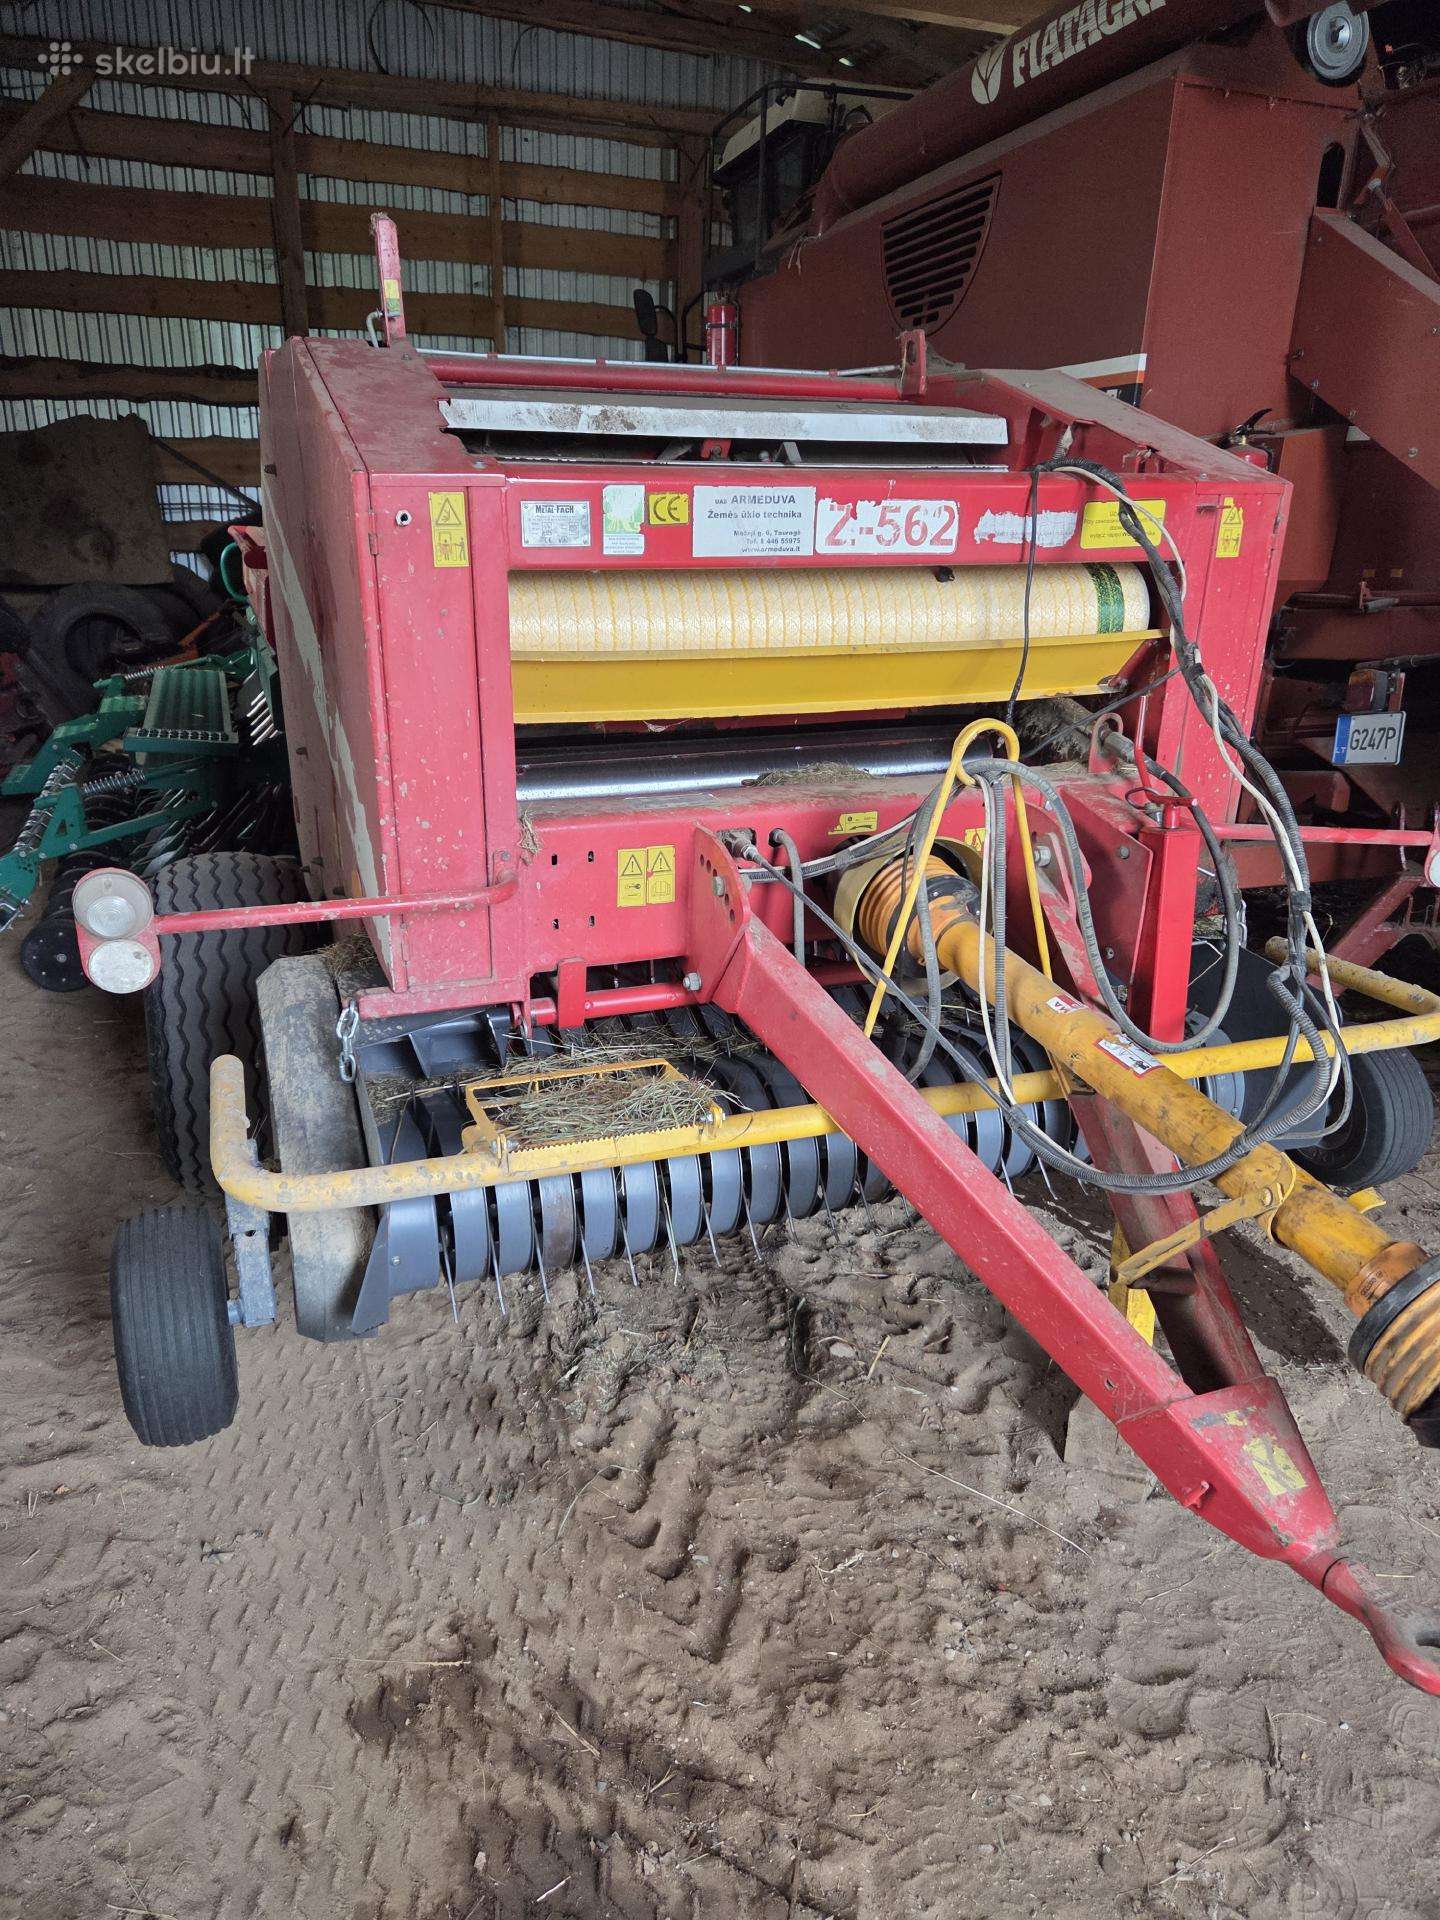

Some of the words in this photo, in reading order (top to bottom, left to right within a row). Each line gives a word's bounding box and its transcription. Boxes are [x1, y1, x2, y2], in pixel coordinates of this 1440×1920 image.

[731, 495, 796, 505] ARMEDUVA
[707, 508, 739, 519] Žemės
[763, 510, 802, 519] technika
[1350, 727, 1397, 750] G247P
